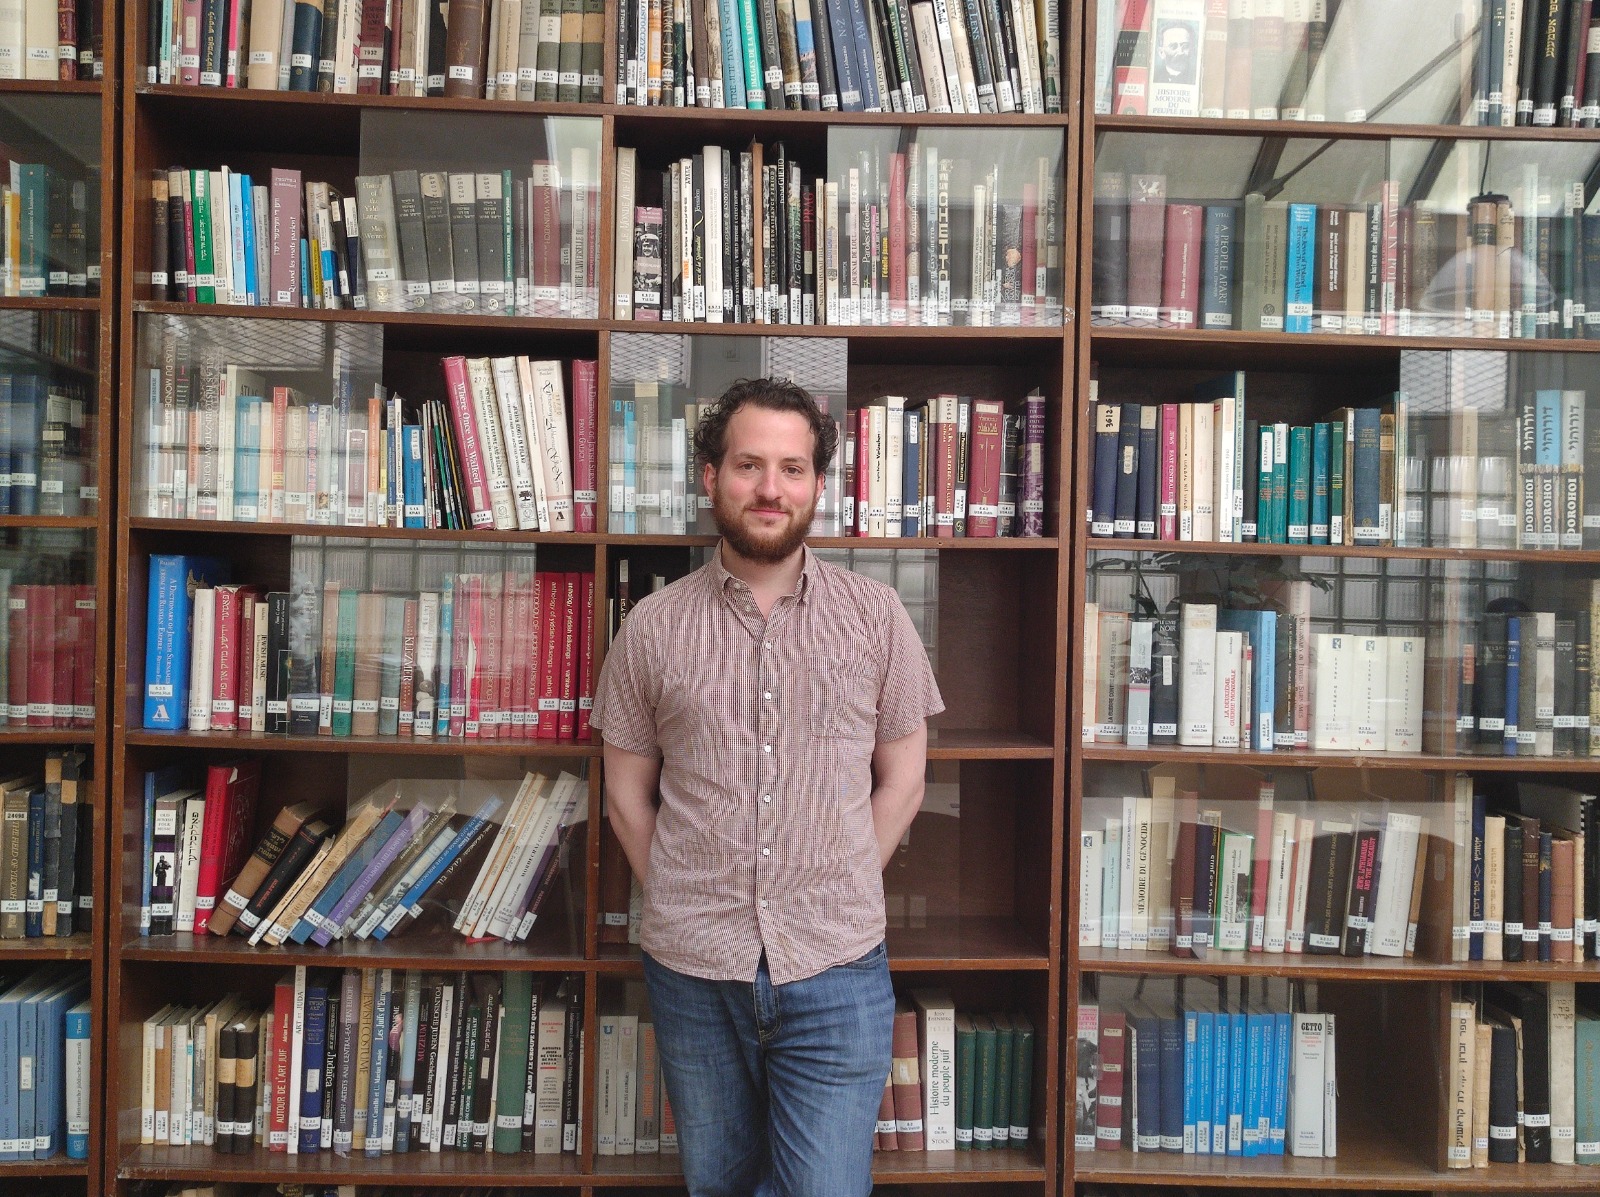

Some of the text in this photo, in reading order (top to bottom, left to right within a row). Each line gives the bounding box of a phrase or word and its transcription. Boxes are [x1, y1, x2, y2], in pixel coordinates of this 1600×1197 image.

[747, 37, 754, 46] LA
[969, 14, 980, 40] LENS
[748, 49, 755, 58] DE
[1157, 88, 1190, 96] HISTOIRE
[803, 192, 814, 222] PRAG
[862, 234, 870, 263] Paroles
[1220, 235, 1228, 270] PEOPLE
[1219, 274, 1228, 306] APART
[166, 365, 172, 376] DU
[458, 382, 480, 484] Where Once We Walked
[1524, 406, 1534, 450] דורוהוי
[1542, 406, 1552, 452] דורוהוי
[1568, 406, 1579, 450] דורוהוי
[1544, 479, 1552, 532] DOROHOI
[1568, 478, 1576, 534] DOROHOI
[168, 585, 177, 621] DICTIONARY
[404, 636, 414, 682] KLEZMER
[1224, 710, 1230, 718] LA
[11, 858, 18, 868] OF
[1138, 821, 1148, 914] MÉMOIRE DU GÉNOCIDE
[1358, 840, 1368, 874] LITHUANIANS
[1366, 837, 1376, 866] HOLOCAUST
[376, 985, 386, 1041] Les Juifs d'Europ
[432, 986, 442, 1026] POLNISCHE
[344, 1010, 352, 1062] CENTRAL-EASTERN
[360, 992, 373, 1074] JEWISH COSTUME
[418, 1024, 426, 1062] MUZEUM
[431, 1026, 439, 1050] JUDEN
[1301, 1022, 1322, 1031] GETTO
[326, 1051, 336, 1086] Judaïca
[428, 1052, 436, 1084] Geschichte
[930, 1041, 939, 1115] Histoire moderne
[940, 1049, 952, 1106] du peuple juif
[276, 1049, 287, 1124] AUTOUR DE L'ART JUIF
